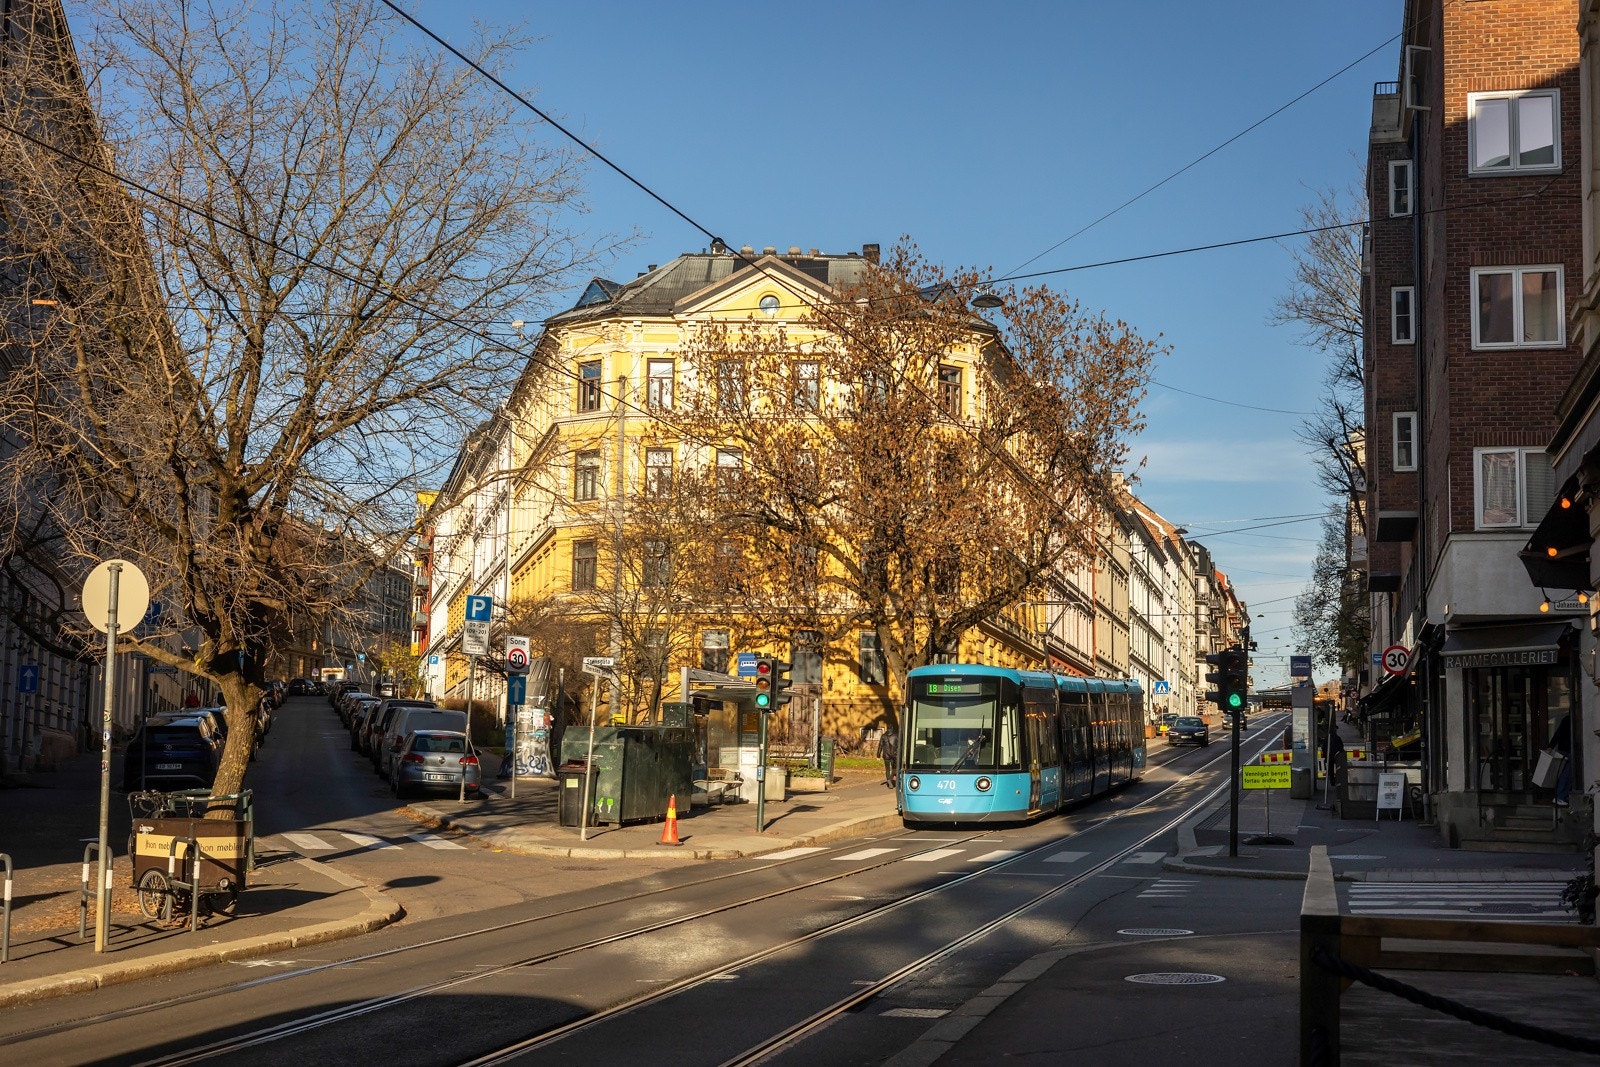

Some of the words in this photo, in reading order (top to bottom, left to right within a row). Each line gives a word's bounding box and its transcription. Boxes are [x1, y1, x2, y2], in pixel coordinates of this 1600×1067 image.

[471, 598, 486, 618] P
[510, 637, 526, 646] Sone
[512, 653, 524, 665] 30
[1387, 652, 1407, 667] 30
[1446, 650, 1556, 668] RAMMEGALLERIET
[928, 684, 938, 693] 18
[943, 684, 961, 692] Disen
[937, 780, 956, 789] 470
